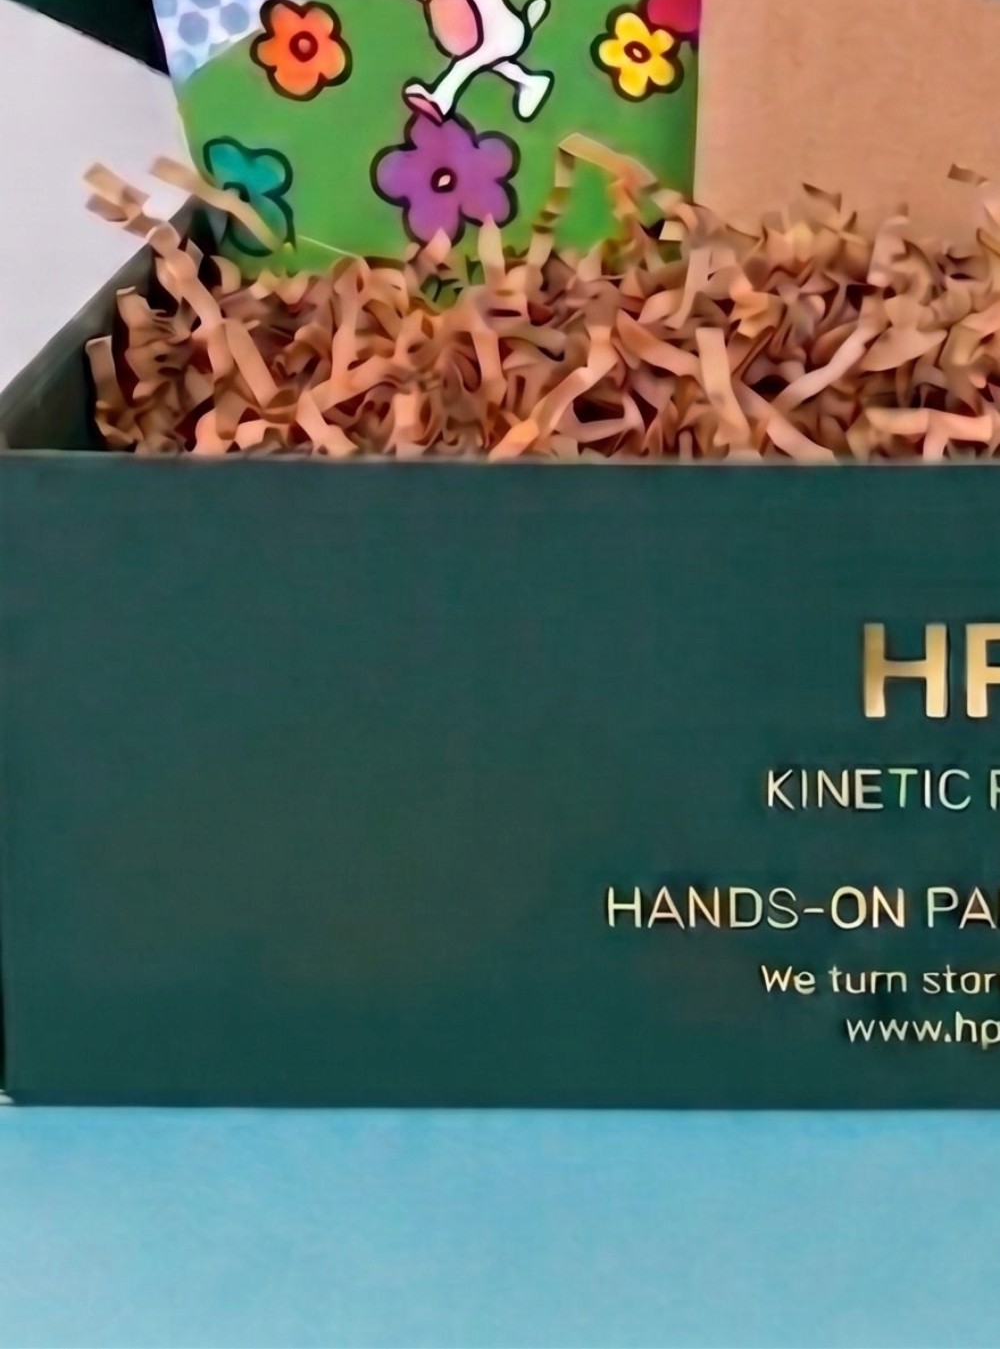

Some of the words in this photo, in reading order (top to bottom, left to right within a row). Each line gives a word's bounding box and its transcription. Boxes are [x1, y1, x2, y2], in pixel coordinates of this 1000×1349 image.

[766, 767, 973, 811] KINETIC
[606, 885, 906, 930] HANDS-ON
[761, 964, 816, 995] We
[827, 963, 908, 995] turn
